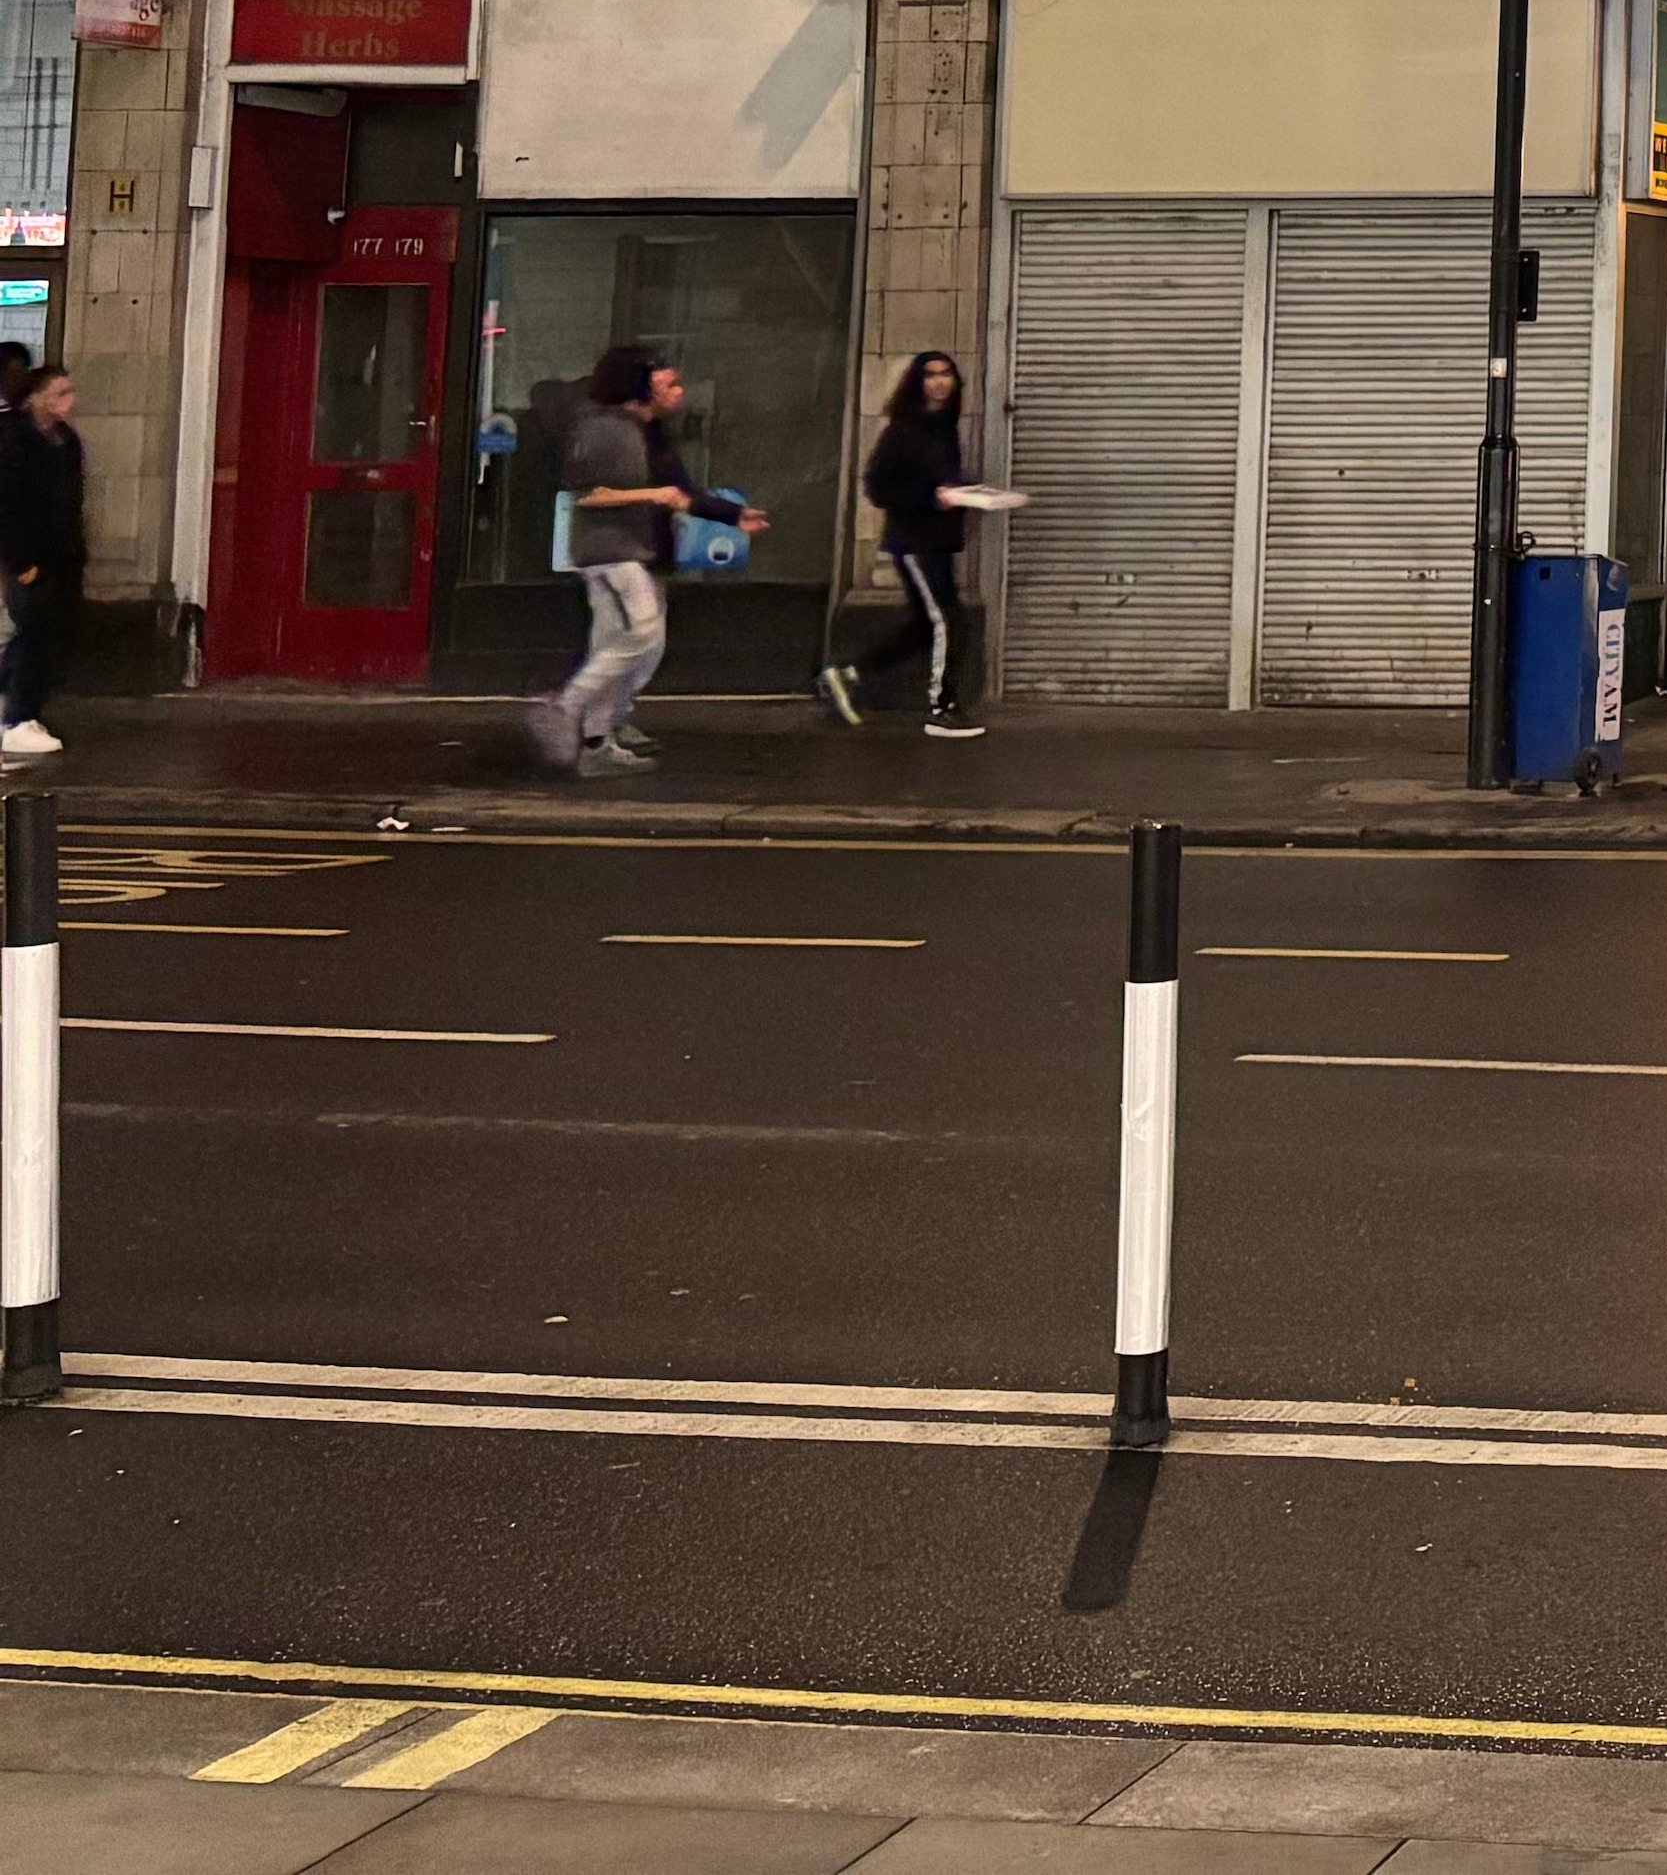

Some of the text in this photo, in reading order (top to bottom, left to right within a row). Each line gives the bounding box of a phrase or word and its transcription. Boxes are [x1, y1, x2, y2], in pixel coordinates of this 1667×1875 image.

[300, 30, 400, 58] Herbs
[353, 237, 424, 255] 177 179
